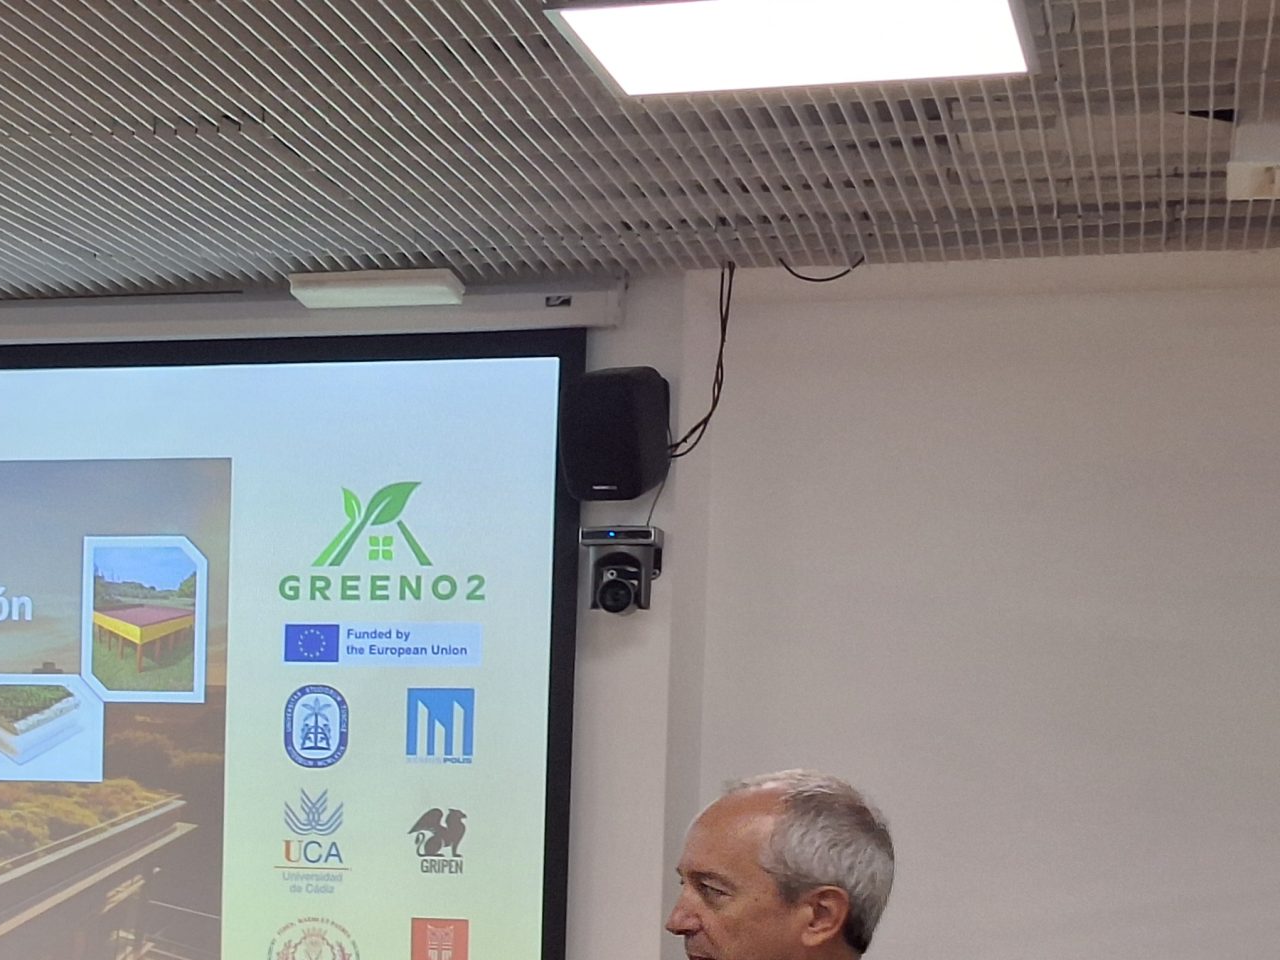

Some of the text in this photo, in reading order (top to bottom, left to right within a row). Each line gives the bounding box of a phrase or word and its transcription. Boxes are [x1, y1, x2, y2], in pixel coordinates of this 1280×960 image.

[279, 575, 485, 600] GREENO2
[347, 629, 410, 642] Funded by
[346, 645, 467, 658] the European Union
[283, 840, 343, 864] UCA
[421, 859, 463, 875] GRIPEN
[283, 872, 343, 883] Universidad
[290, 884, 302, 893] de
